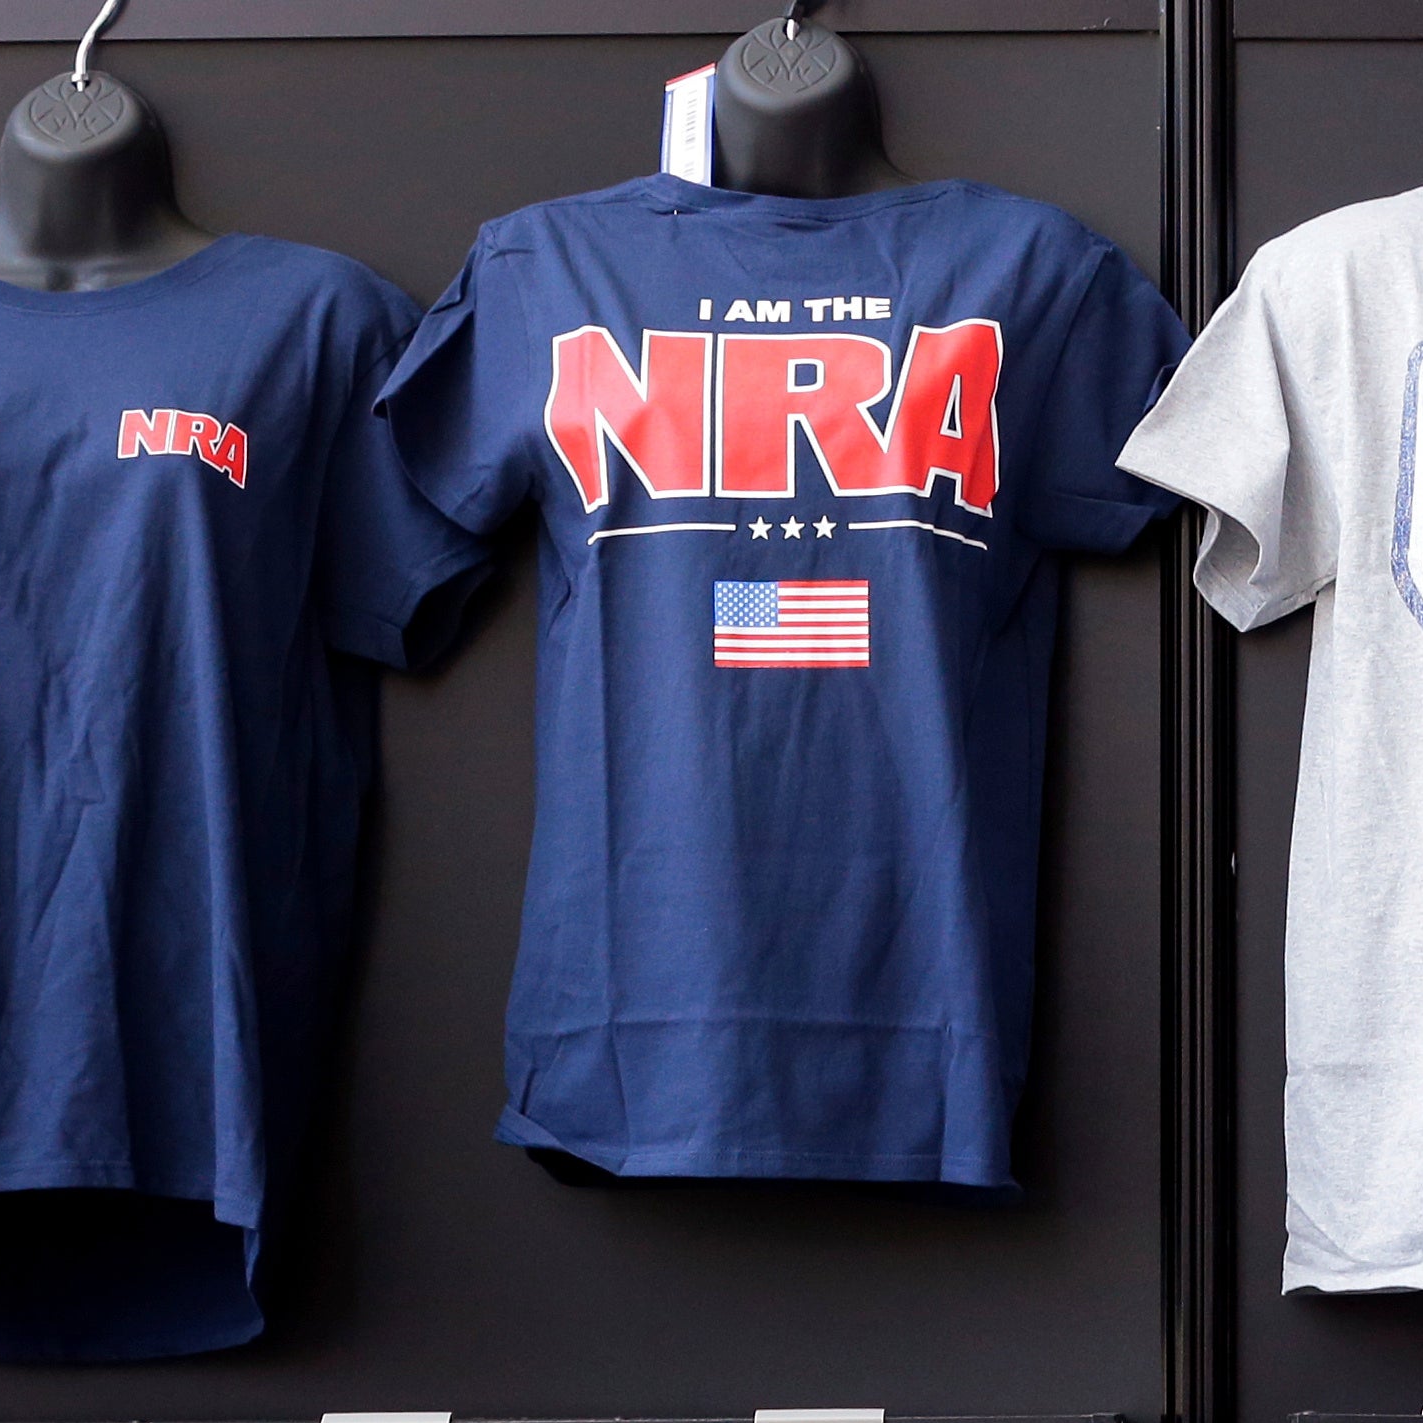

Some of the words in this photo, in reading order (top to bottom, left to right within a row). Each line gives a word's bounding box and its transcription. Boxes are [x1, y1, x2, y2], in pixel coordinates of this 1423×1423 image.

[698, 298, 713, 321] I
[724, 299, 792, 323] AM
[803, 295, 892, 322] THE
[117, 408, 250, 489] NRA
[544, 318, 1004, 518] NRA
